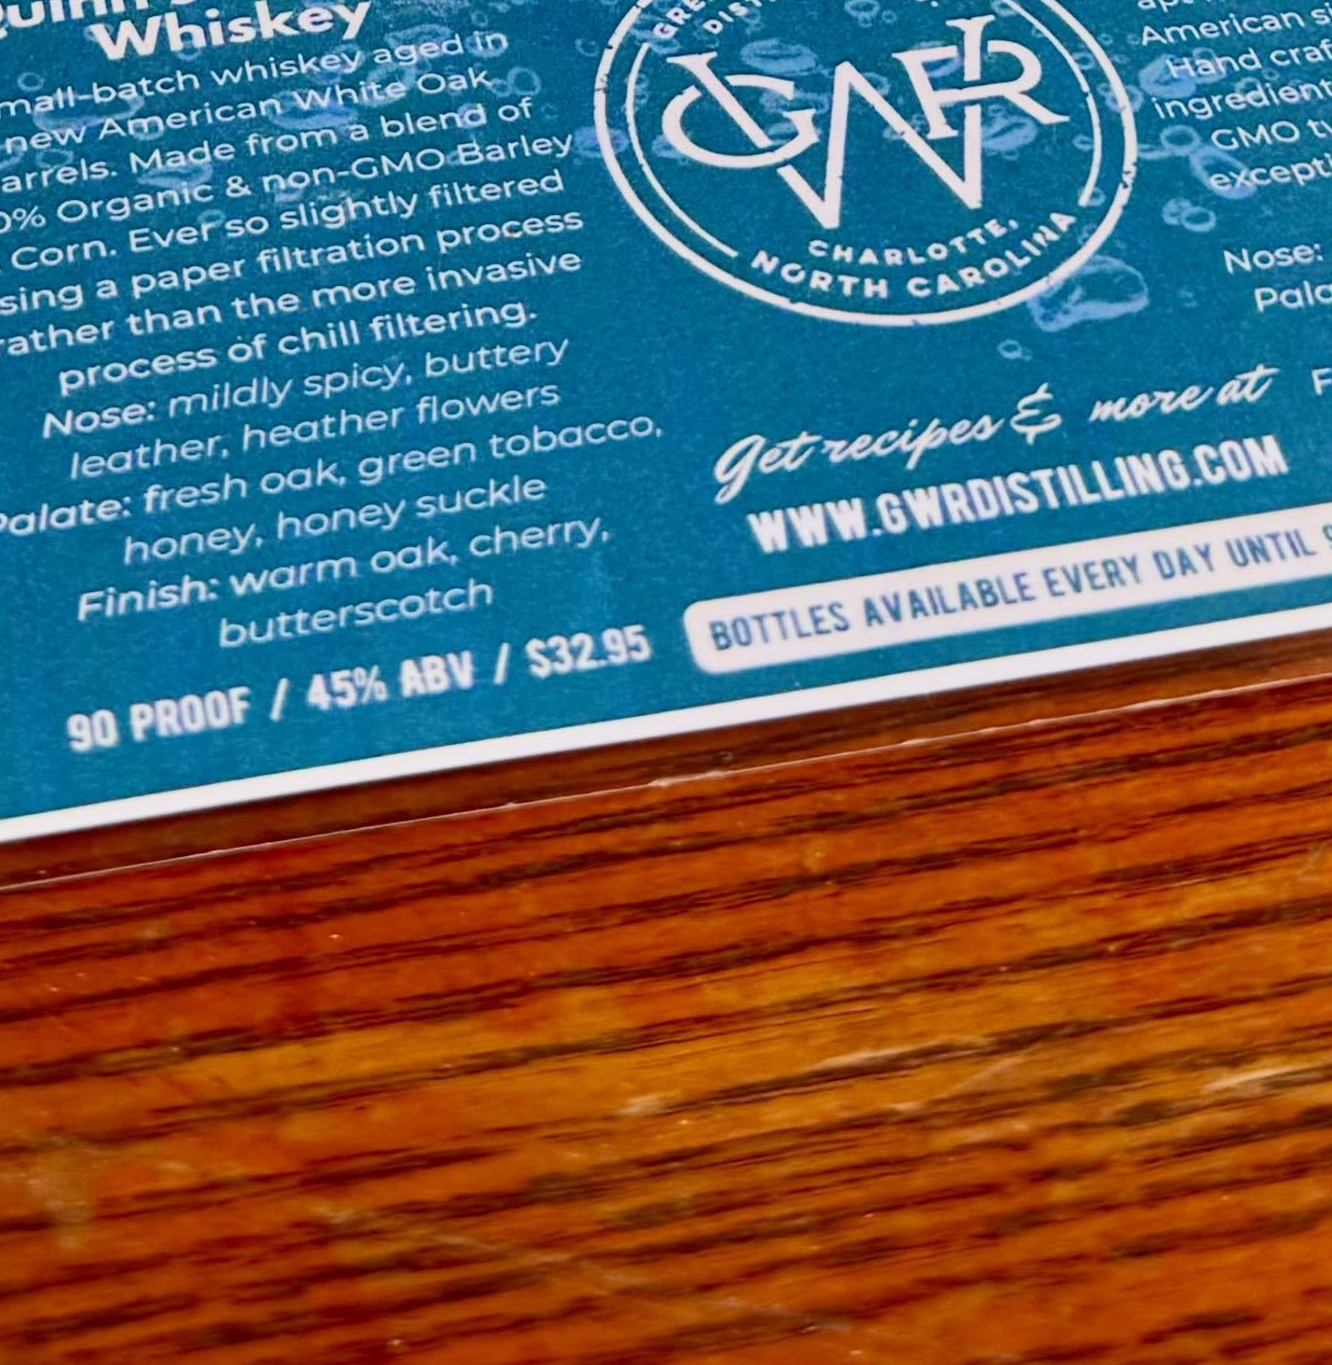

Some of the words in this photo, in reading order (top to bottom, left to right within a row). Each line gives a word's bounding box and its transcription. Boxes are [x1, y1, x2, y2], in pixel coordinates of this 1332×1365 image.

[1140, 9, 1307, 47] American
[56, 179, 214, 224] Organic
[224, 173, 253, 199] &
[260, 146, 447, 194] non-GMO
[454, 132, 574, 167] Barley
[749, 249, 890, 300] NORTH
[906, 211, 1077, 298] CAROLINA
[808, 218, 1020, 266] CHARLOTTE,
[142, 471, 249, 514] fresh
[258, 456, 348, 495] oak,
[356, 440, 478, 487] green
[487, 414, 663, 460] tobacco,
[712, 429, 823, 505] Get
[820, 412, 1005, 471] recipes
[1009, 380, 1064, 445] &
[1088, 383, 1215, 422] more
[1215, 361, 1280, 407] at
[746, 432, 1290, 554] WWW.GWRDISTILLING.COM
[708, 600, 851, 652] BOTTLES
[863, 570, 1035, 627] AVAILABLE
[1041, 554, 1139, 598] EVERY
[1151, 543, 1211, 581] DAY
[1225, 529, 1314, 568] UNTIL
[66, 707, 120, 753] 90
[128, 684, 251, 742] PROOF
[306, 663, 390, 712] 45%
[398, 648, 475, 698] ABV
[524, 622, 653, 679] $32.95
